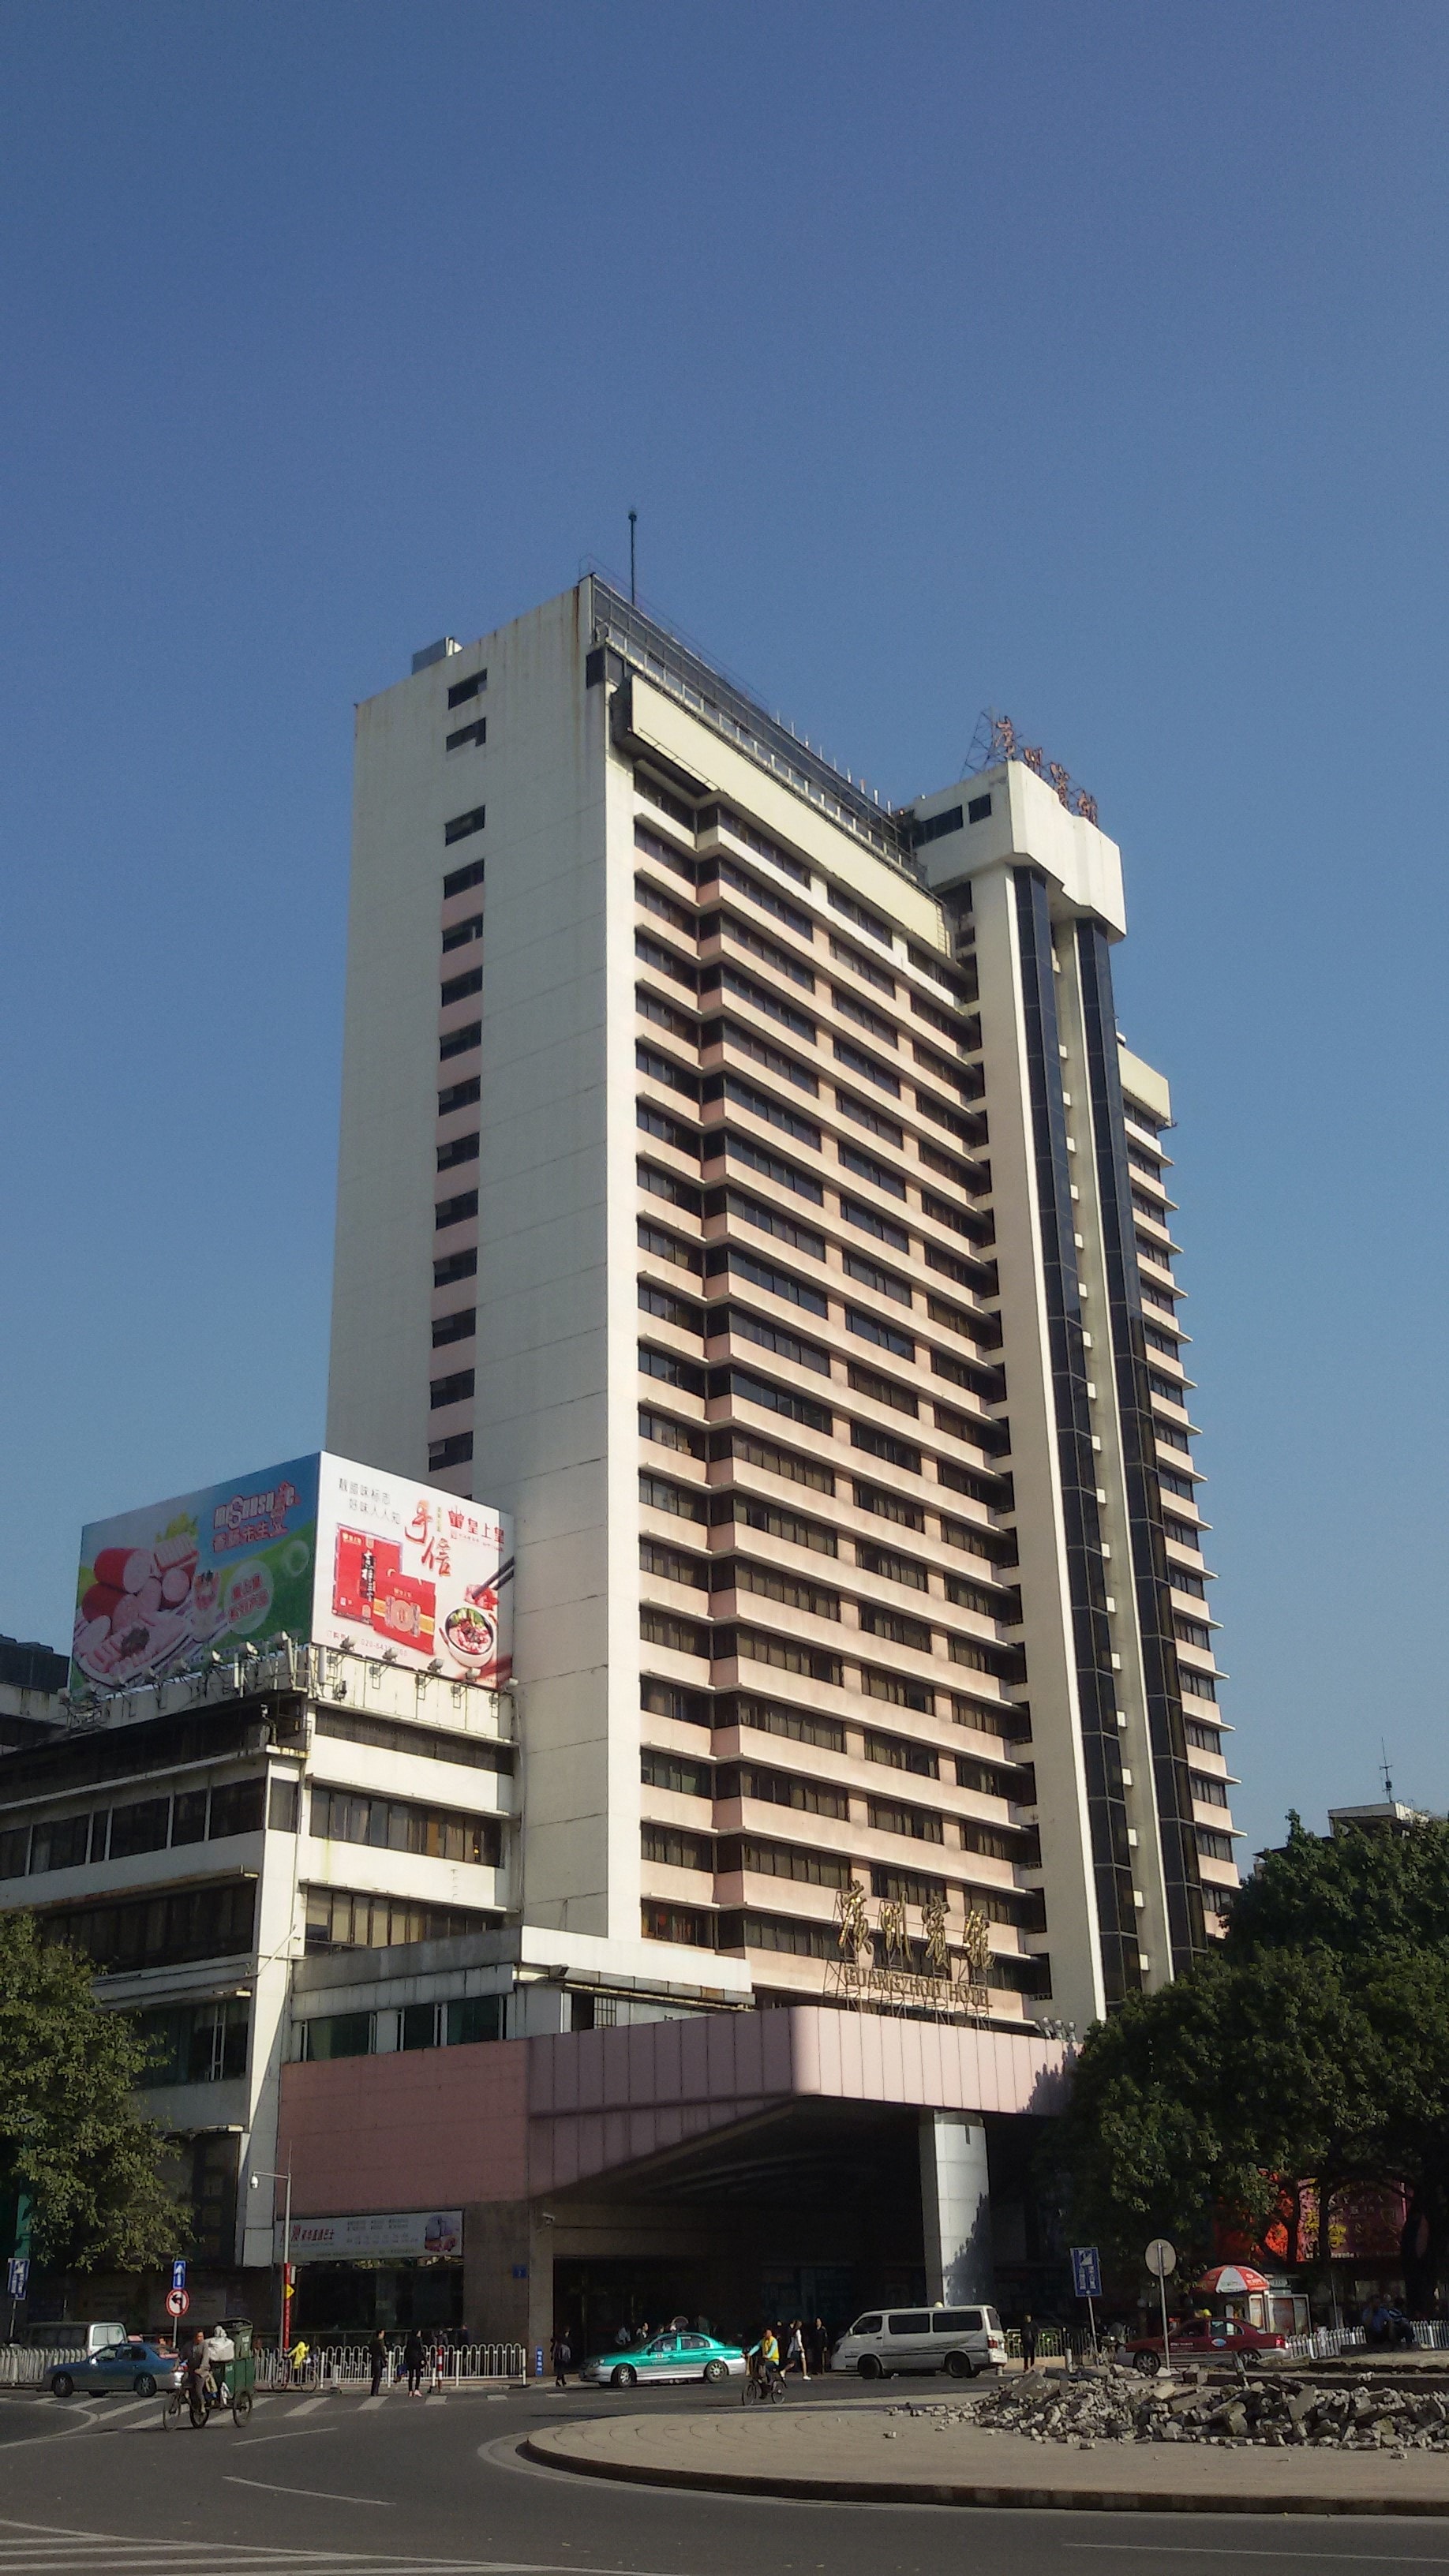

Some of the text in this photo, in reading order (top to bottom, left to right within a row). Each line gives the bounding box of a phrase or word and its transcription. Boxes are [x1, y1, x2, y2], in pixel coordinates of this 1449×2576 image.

[467, 1518, 504, 1544] 皇上皇
[948, 1982, 994, 2008] HOTEL
